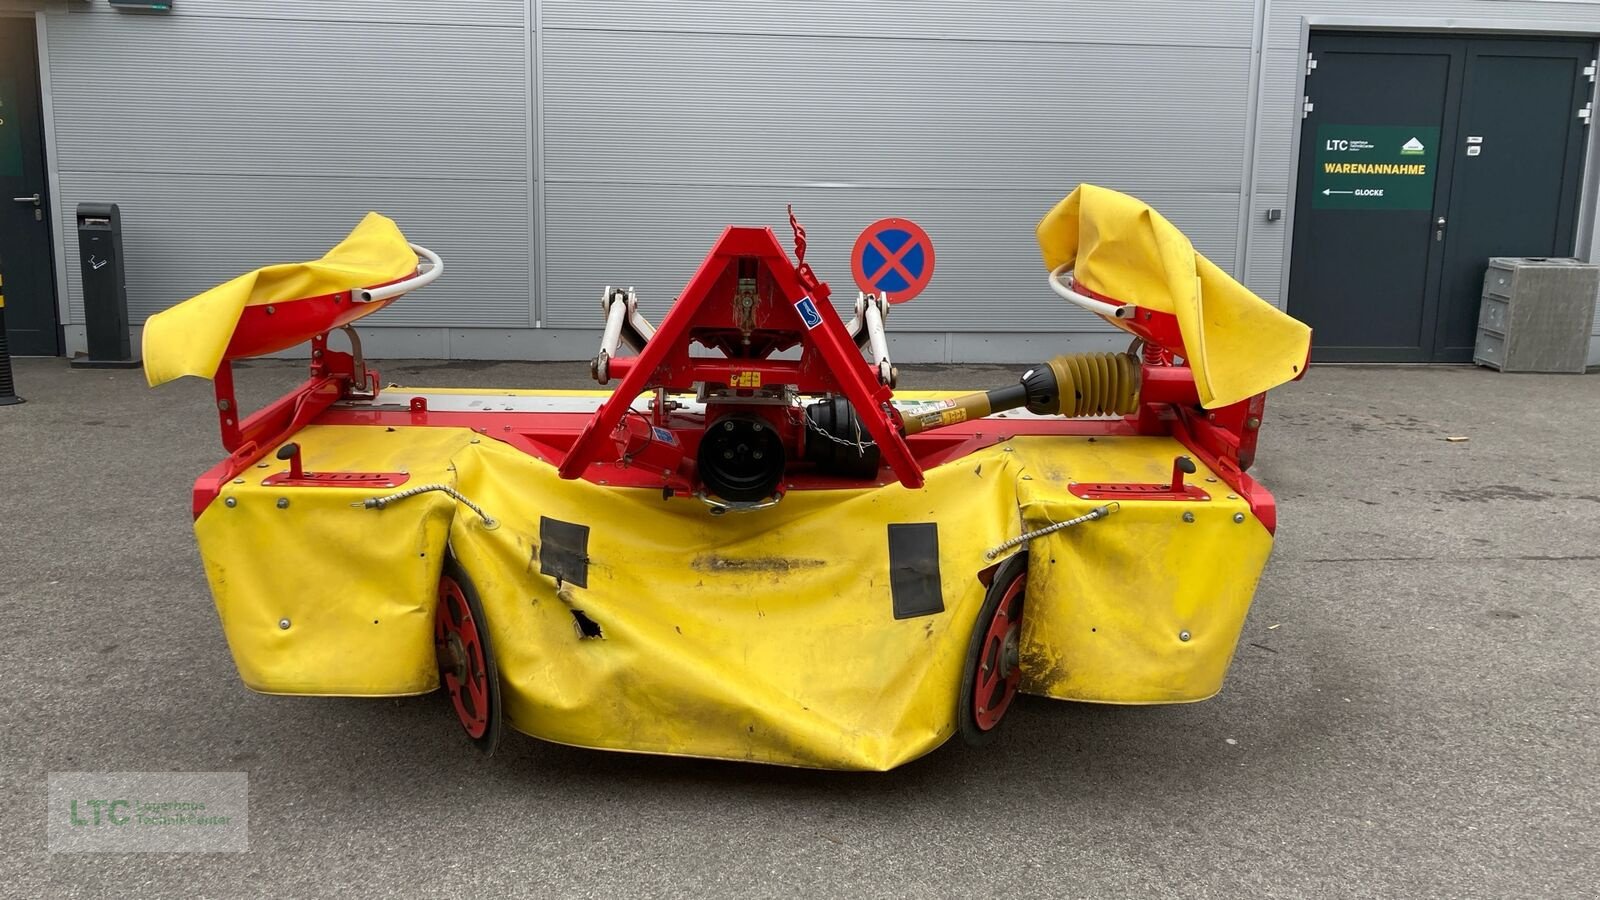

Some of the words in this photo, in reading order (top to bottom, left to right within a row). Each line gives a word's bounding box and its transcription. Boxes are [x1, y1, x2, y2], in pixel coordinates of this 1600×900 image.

[1326, 139, 1348, 151] LTC
[1324, 162, 1426, 175] WARENANNAHME
[1354, 189, 1384, 197] GLOCKE
